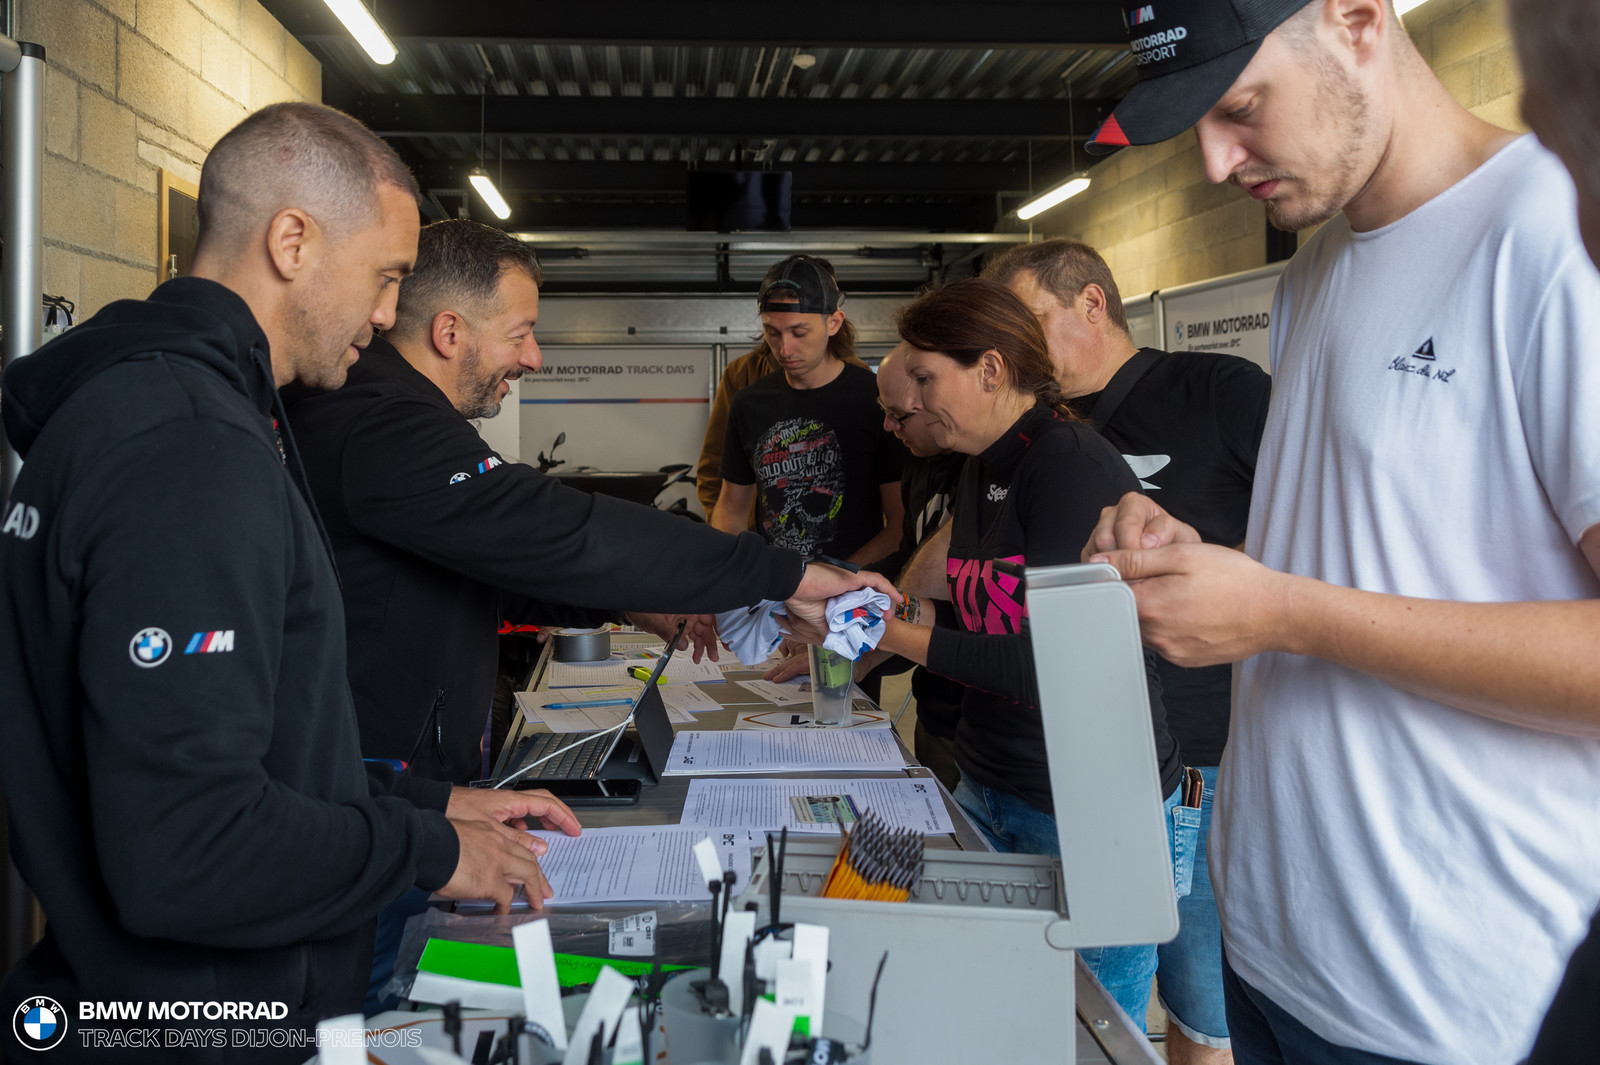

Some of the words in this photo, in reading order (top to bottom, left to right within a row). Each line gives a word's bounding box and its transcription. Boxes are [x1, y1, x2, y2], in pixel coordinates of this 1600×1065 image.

[1188, 321, 1211, 339] BMW
[1213, 312, 1270, 335] MOTORRAD
[557, 366, 623, 375] MOTORRAD
[627, 365, 663, 375] TRACK
[666, 365, 695, 374] DAYS
[757, 462, 781, 480] SOLD
[781, 456, 803, 473] OUT
[986, 484, 1010, 502] Spee
